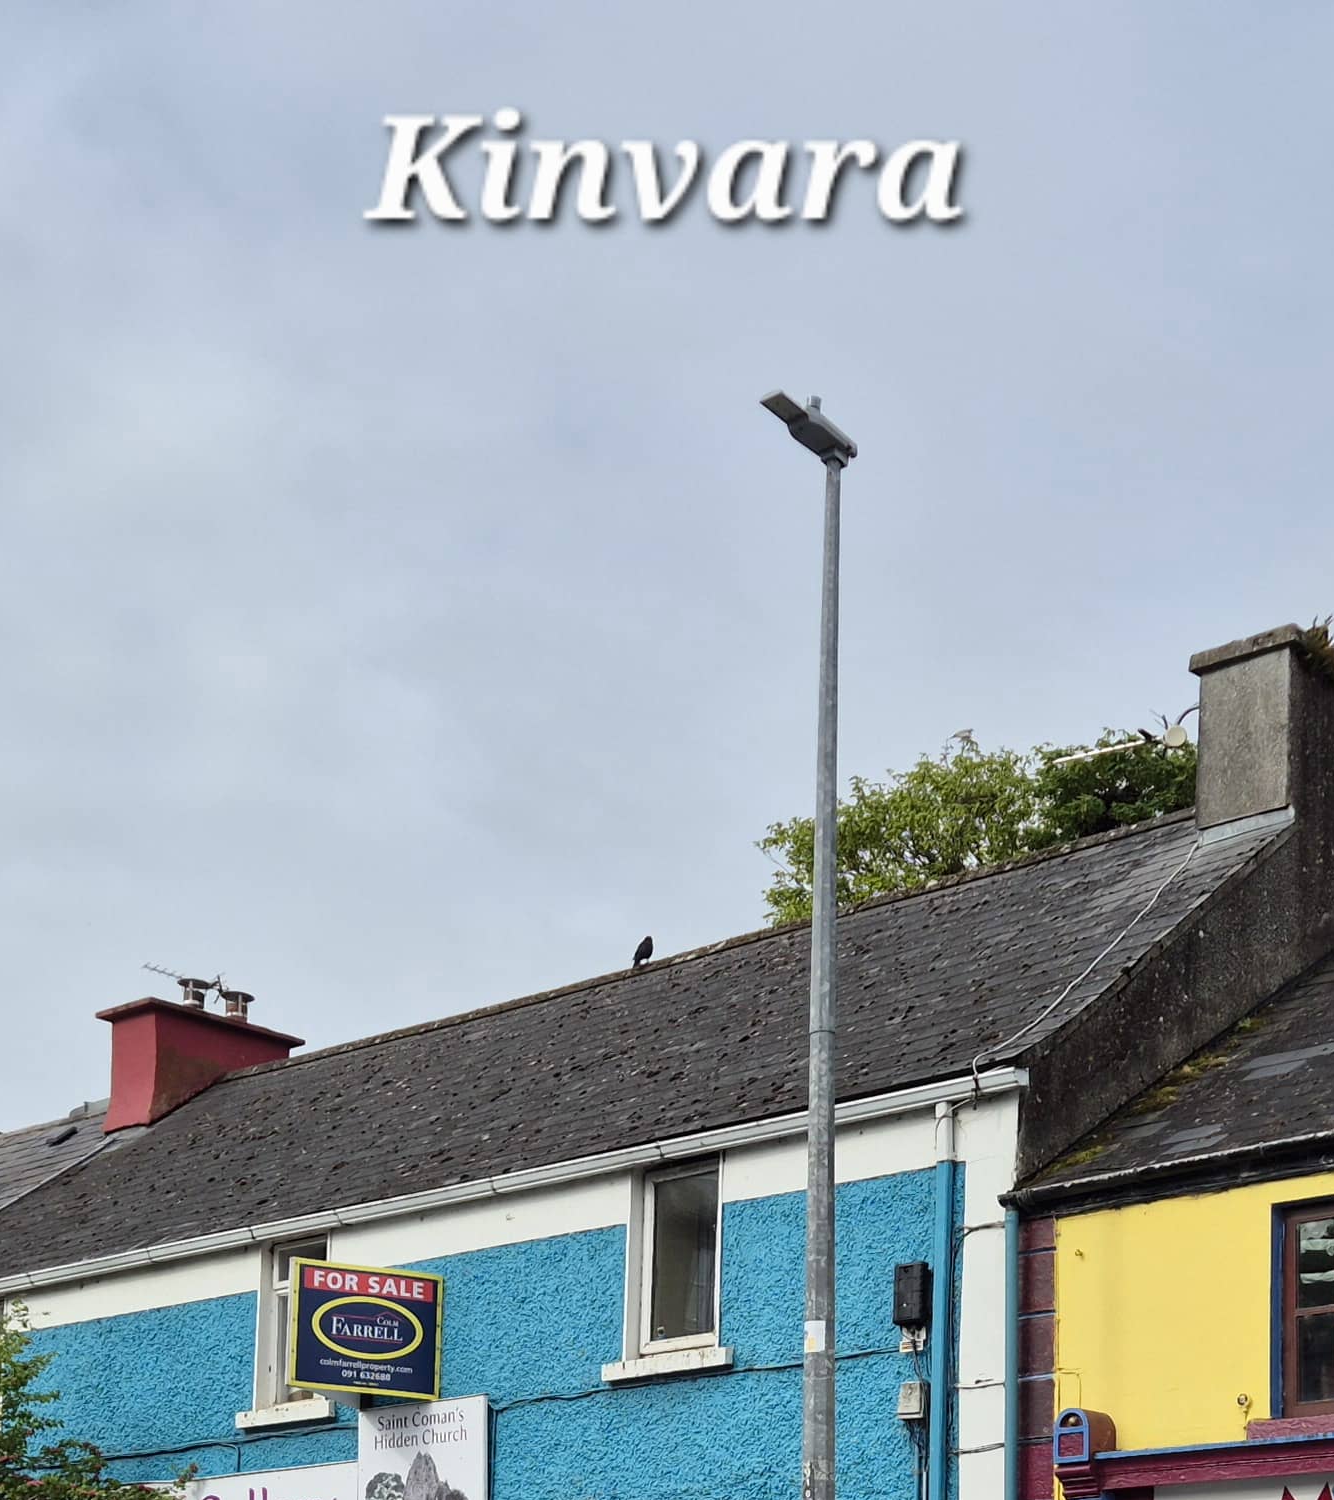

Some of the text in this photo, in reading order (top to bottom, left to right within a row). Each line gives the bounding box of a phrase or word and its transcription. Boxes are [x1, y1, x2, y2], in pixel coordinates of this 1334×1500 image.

[313, 1270, 425, 1299] FOR SALE
[331, 1316, 403, 1342] FARRELL
[377, 1407, 465, 1431] Saint Coman's
[374, 1424, 468, 1450] Hidden Church
